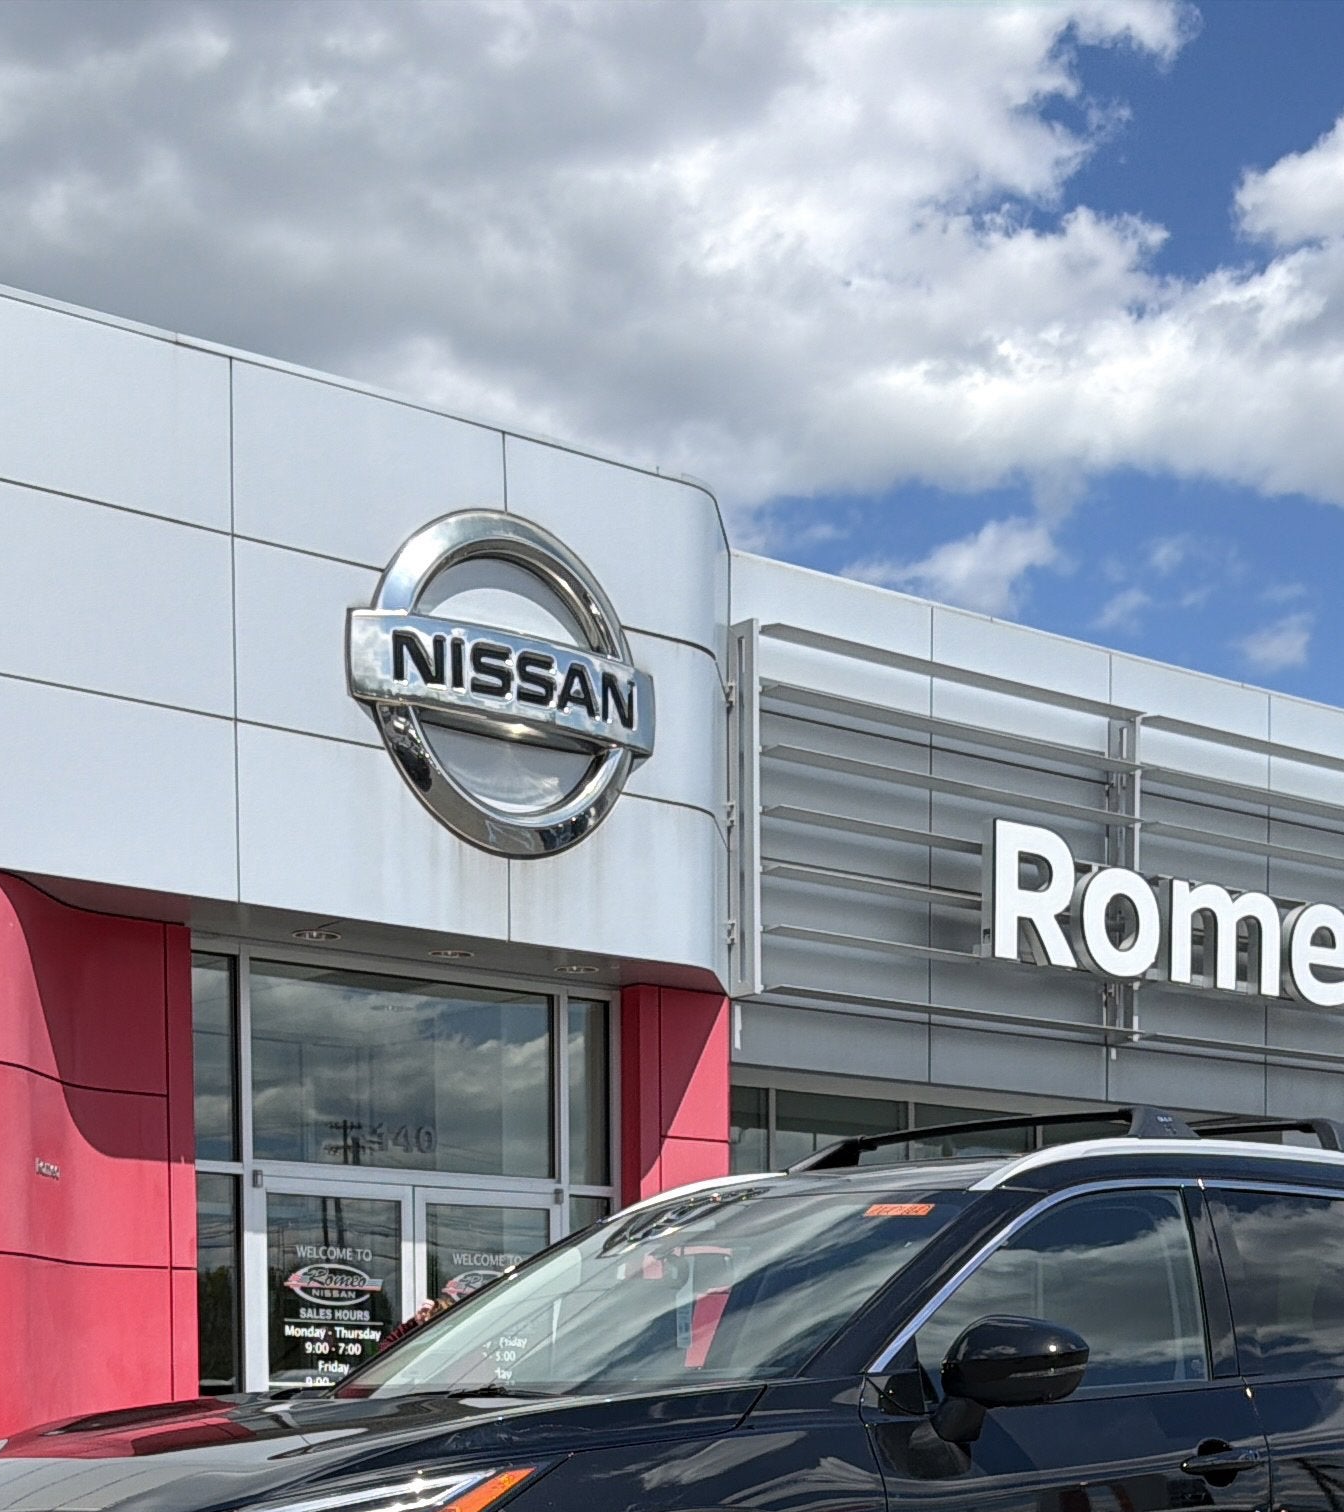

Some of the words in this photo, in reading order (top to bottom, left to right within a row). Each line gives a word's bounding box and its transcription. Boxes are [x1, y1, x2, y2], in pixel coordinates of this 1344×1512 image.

[392, 628, 636, 731] NISSAN
[295, 1245, 353, 1261] WELCOME
[356, 1248, 373, 1262] TO
[452, 1253, 505, 1267] WELCOME
[304, 1267, 367, 1288] Romeo
[311, 1288, 356, 1299] NISSAN
[299, 1307, 332, 1320] SALES
[335, 1309, 370, 1321] HOURS
[284, 1325, 327, 1340] Monday
[334, 1326, 382, 1342] Thursday
[305, 1341, 330, 1354] 9:00
[338, 1343, 362, 1355] 7:00
[318, 1360, 350, 1376] Friday
